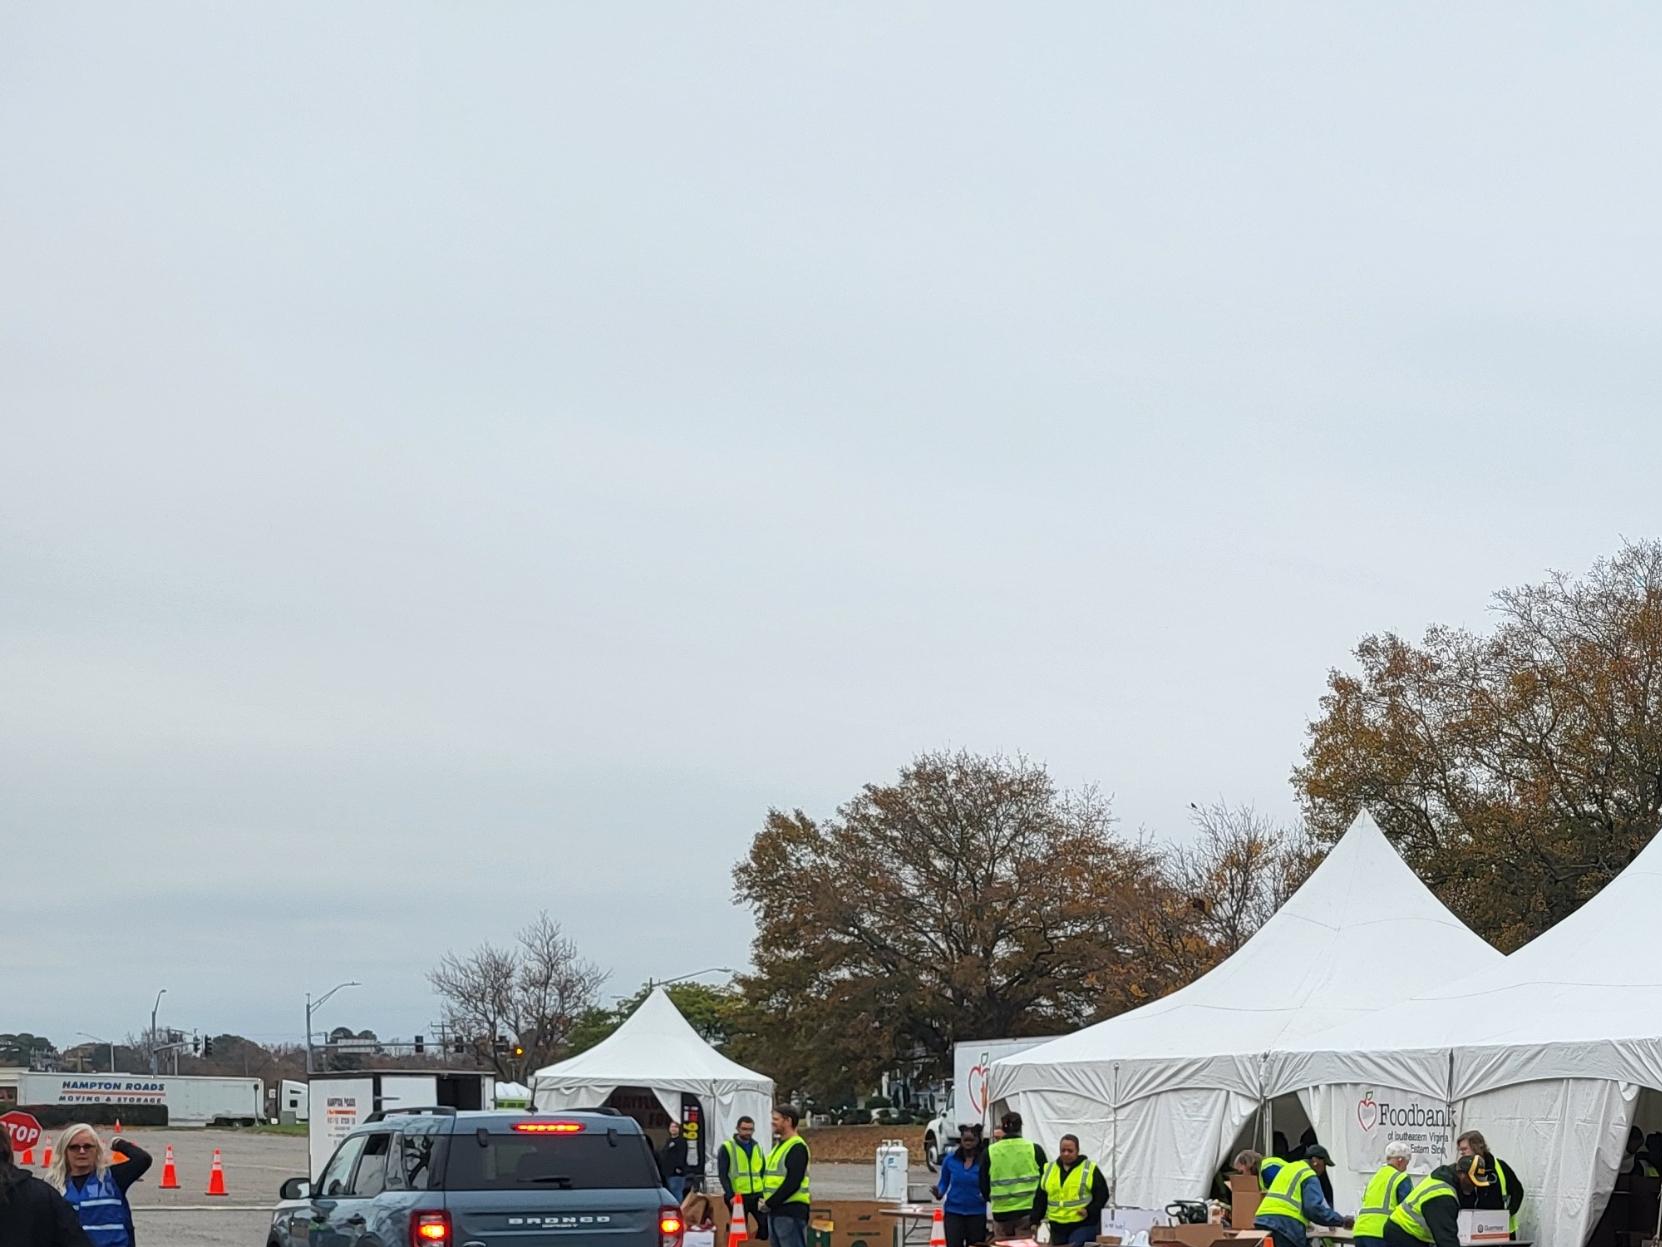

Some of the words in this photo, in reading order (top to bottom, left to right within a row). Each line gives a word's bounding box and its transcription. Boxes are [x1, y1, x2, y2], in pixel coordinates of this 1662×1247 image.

[62, 1081, 122, 1091] HAMPTON
[125, 1082, 166, 1091] ROADS
[1379, 1103, 1457, 1128] Foodbank
[0, 1121, 38, 1143] TOP
[508, 1216, 611, 1225] BRONCO
